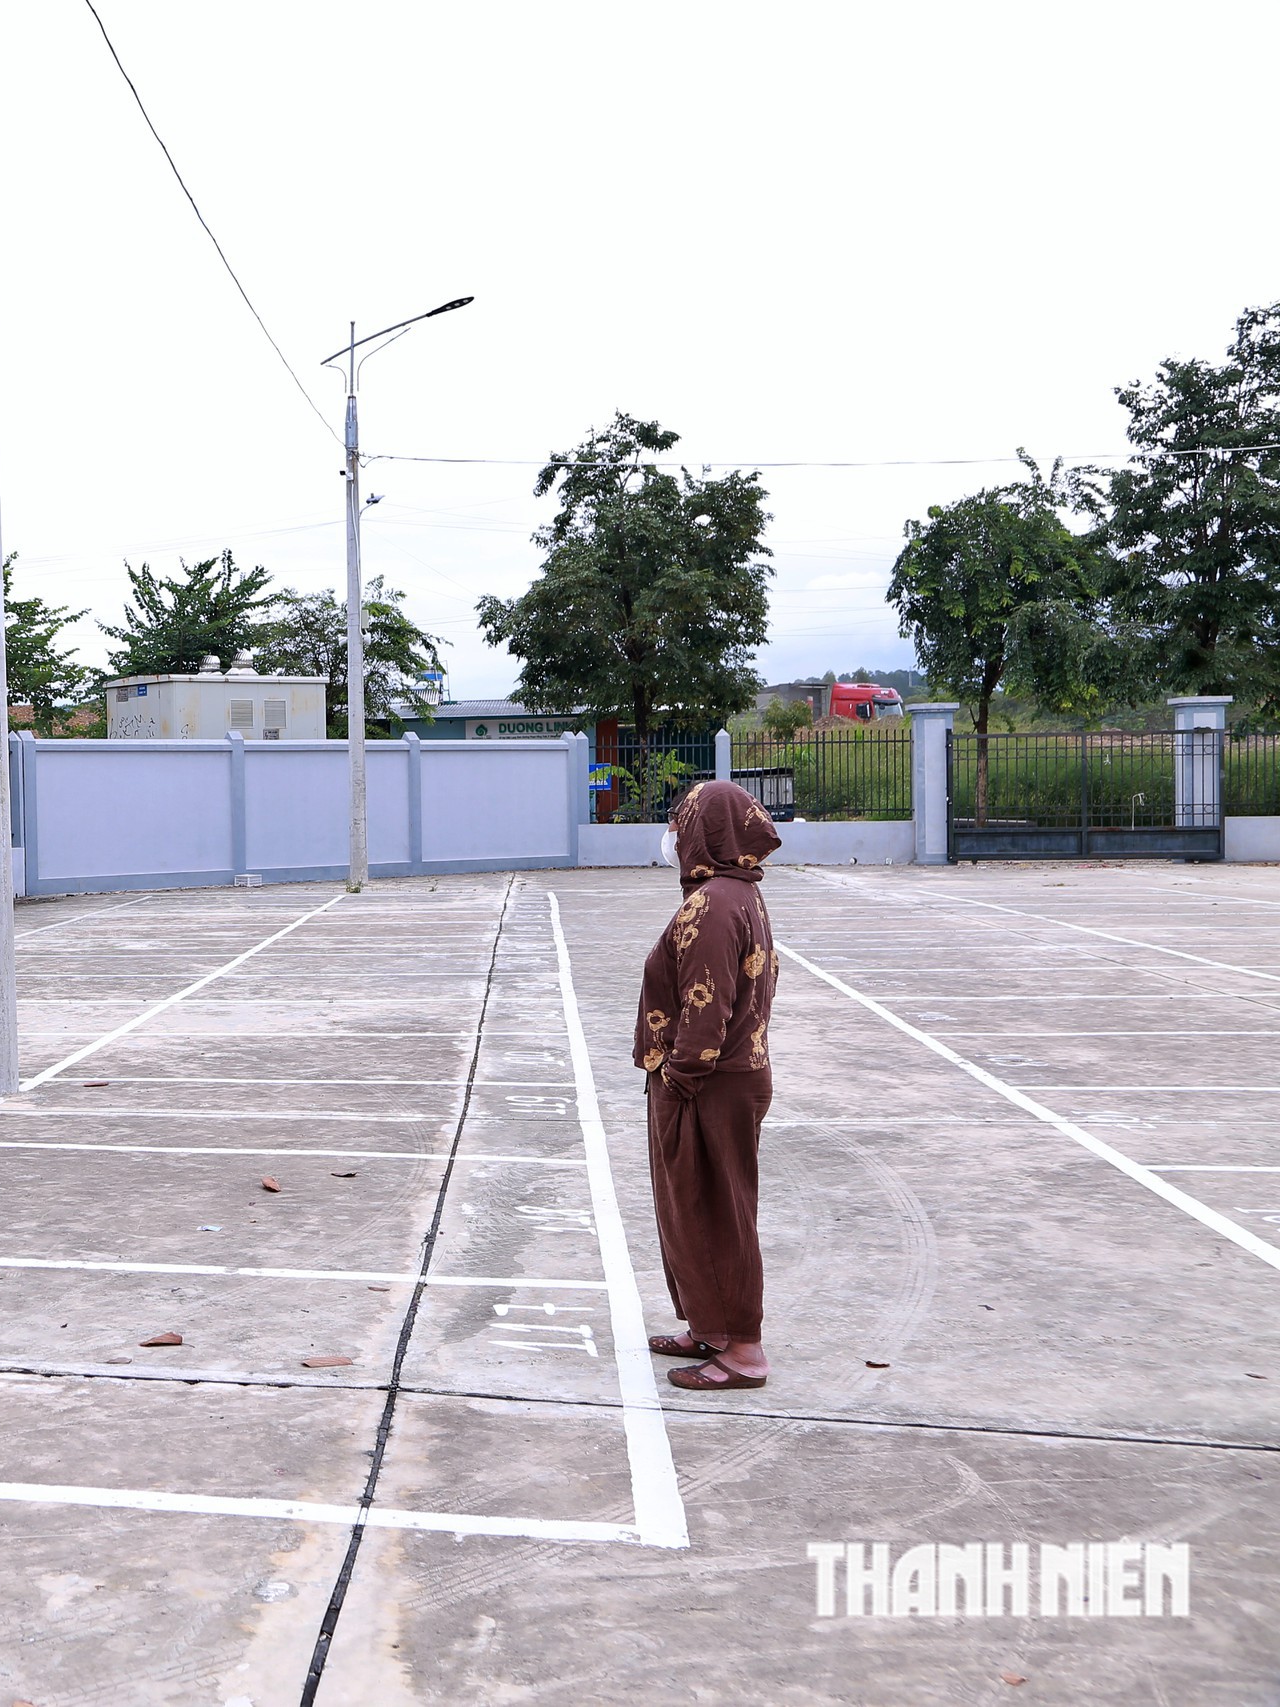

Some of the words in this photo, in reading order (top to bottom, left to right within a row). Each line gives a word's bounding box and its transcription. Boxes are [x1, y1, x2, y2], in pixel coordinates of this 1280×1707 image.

[505, 1095, 575, 1115] 119
[515, 1204, 597, 1235] 118
[487, 1302, 599, 1358] 117
